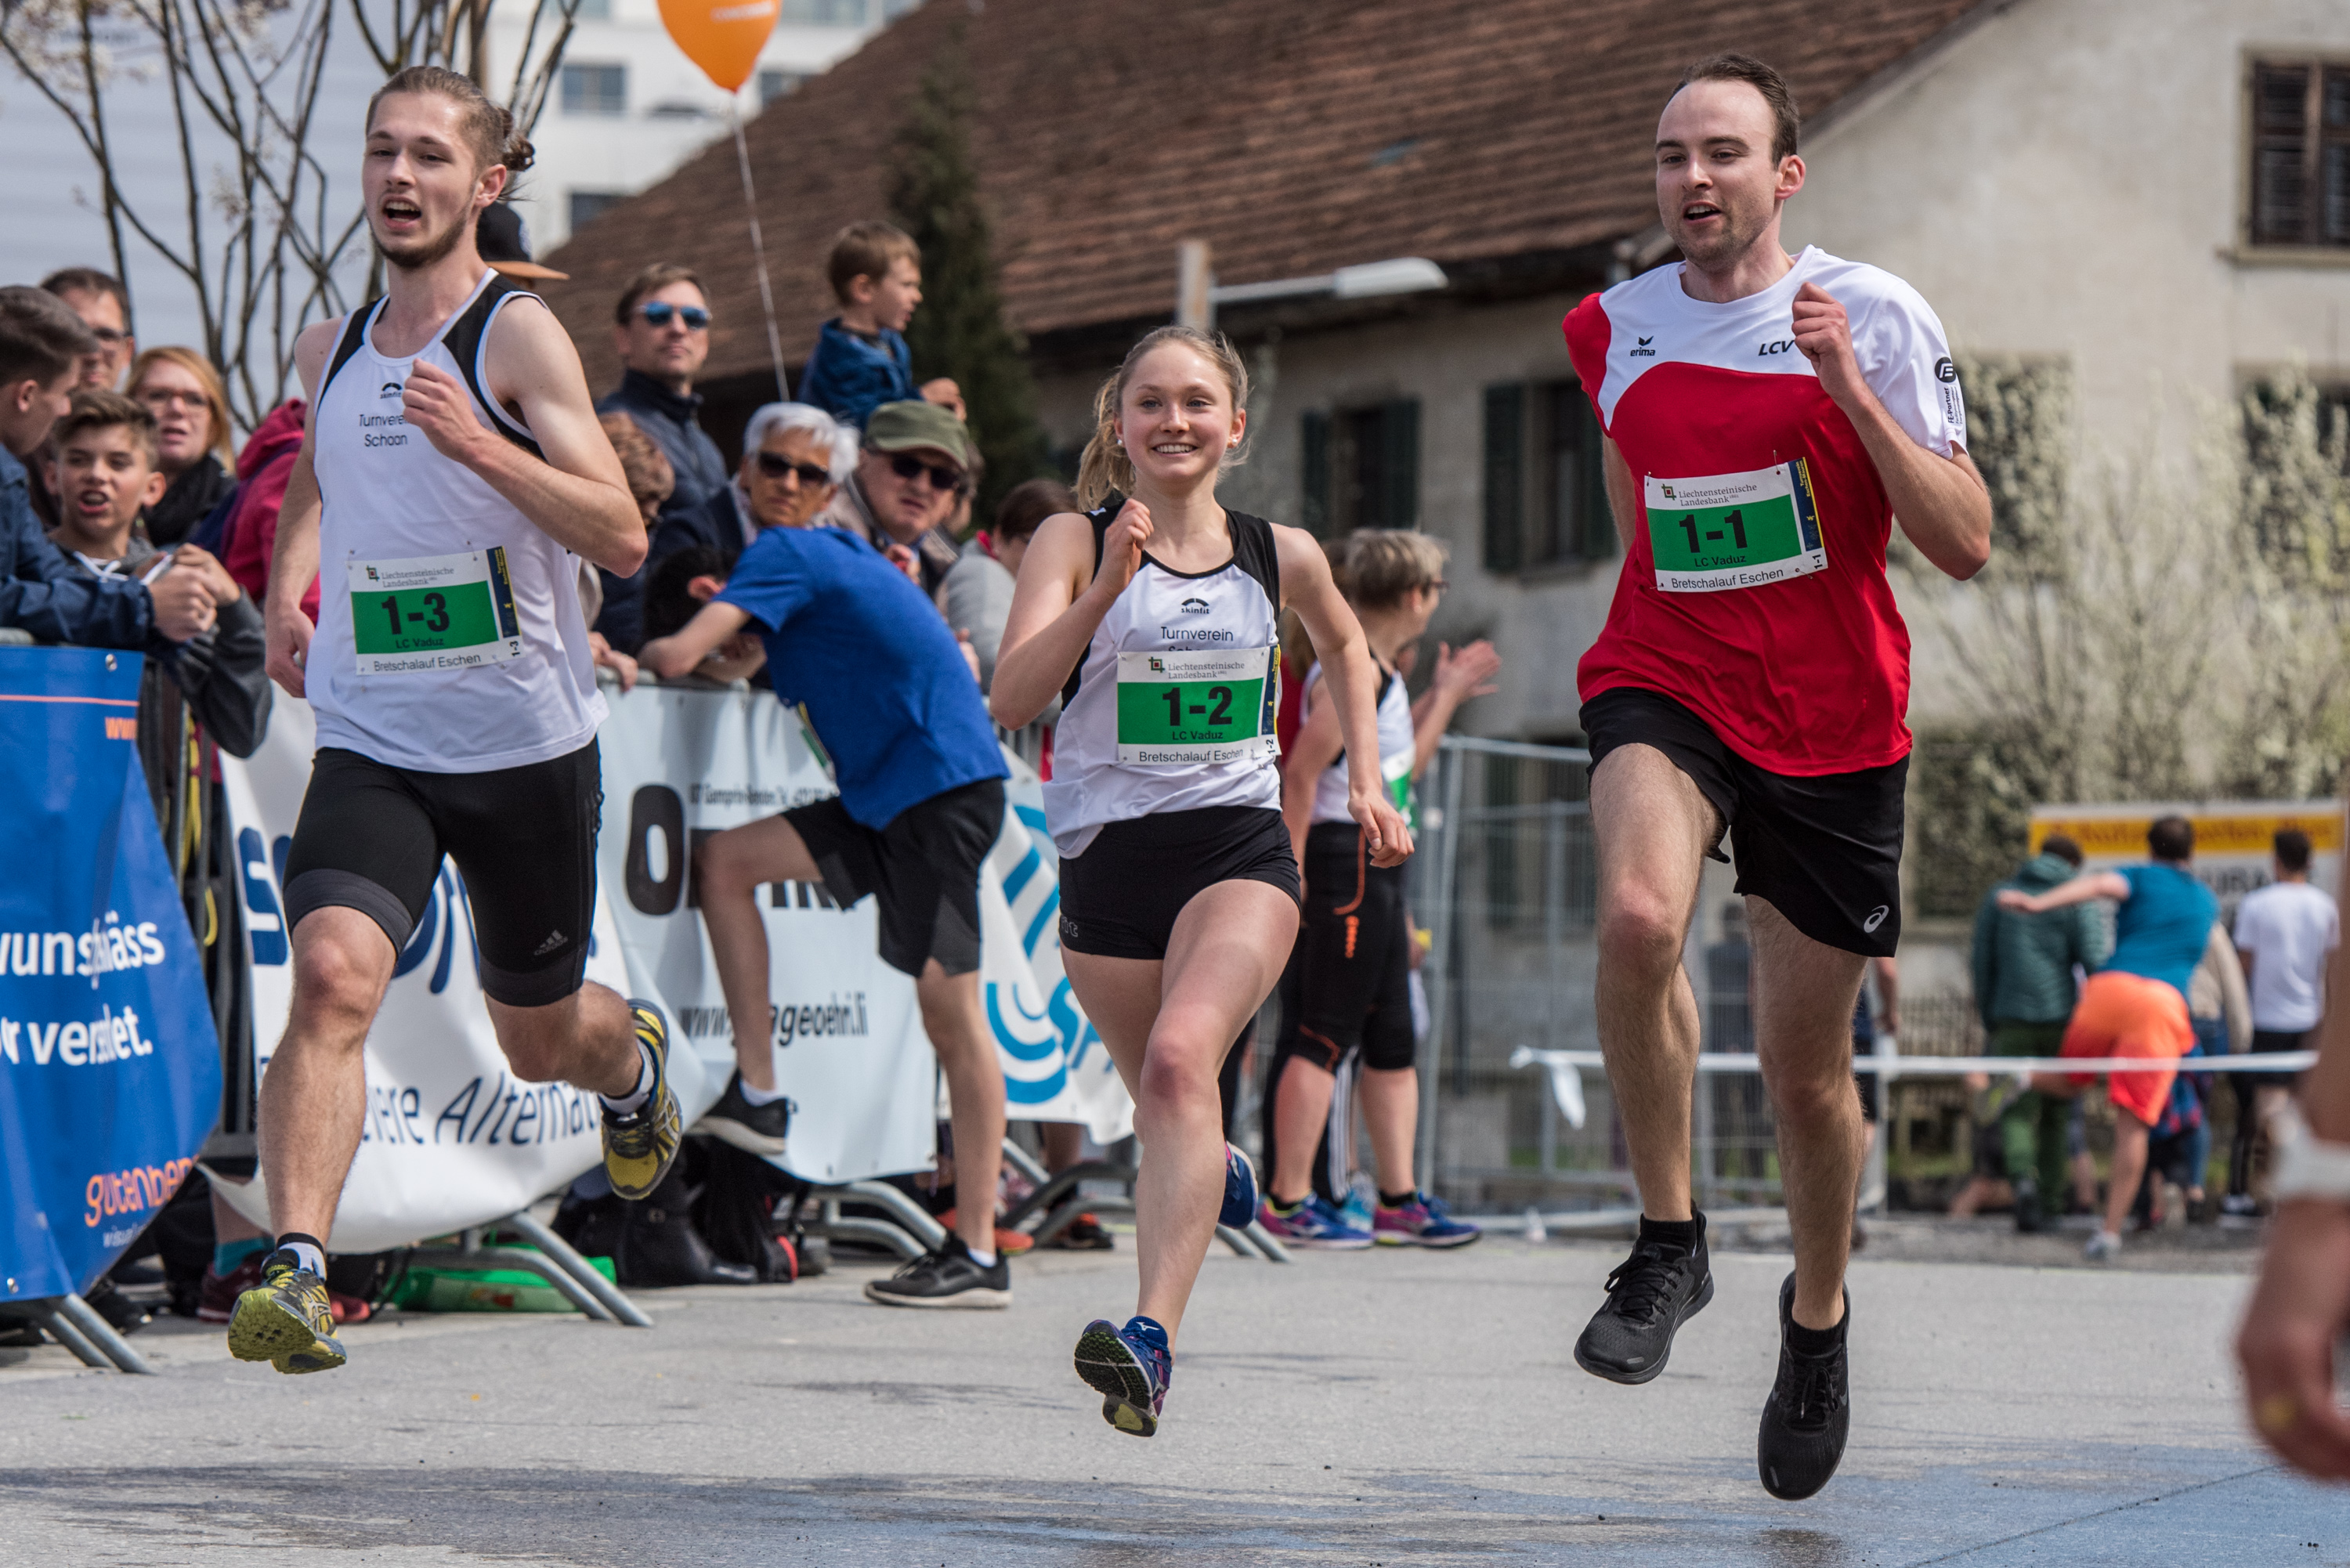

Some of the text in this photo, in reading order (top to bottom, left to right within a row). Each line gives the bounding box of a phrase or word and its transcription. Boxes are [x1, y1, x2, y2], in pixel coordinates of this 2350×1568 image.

[1630, 347, 1656, 356] erima
[1758, 340, 1795, 356] LCV
[1944, 387, 1954, 423] FE-Partner
[360, 414, 407, 427] Turnvere
[1679, 483, 1757, 498] Liechtensteinische
[1679, 496, 1730, 507] Landesbank
[1679, 510, 1748, 553] 1-1
[1694, 555, 1747, 567] LC Vaduz
[1812, 554, 1823, 569] 1-1
[381, 566, 454, 580] Liechtensteinische
[1671, 569, 1784, 589] Bretschalauf Eschen
[382, 578, 428, 588] Landesbank
[381, 592, 450, 635] 1-3
[1160, 627, 1234, 641] Turnverein
[396, 638, 444, 649] LC Vaduz
[509, 641, 520, 657] 1-3
[374, 653, 481, 672] Bretschalauf Eschen
[1168, 661, 1245, 672] Liechtensteinische
[1162, 686, 1232, 727] 1-2
[1172, 731, 1224, 740] LC Vaduz
[1266, 739, 1275, 755] 1-2
[1139, 748, 1243, 762] Bretschalauf Eschen
[85, 1154, 199, 1228] gutenber
